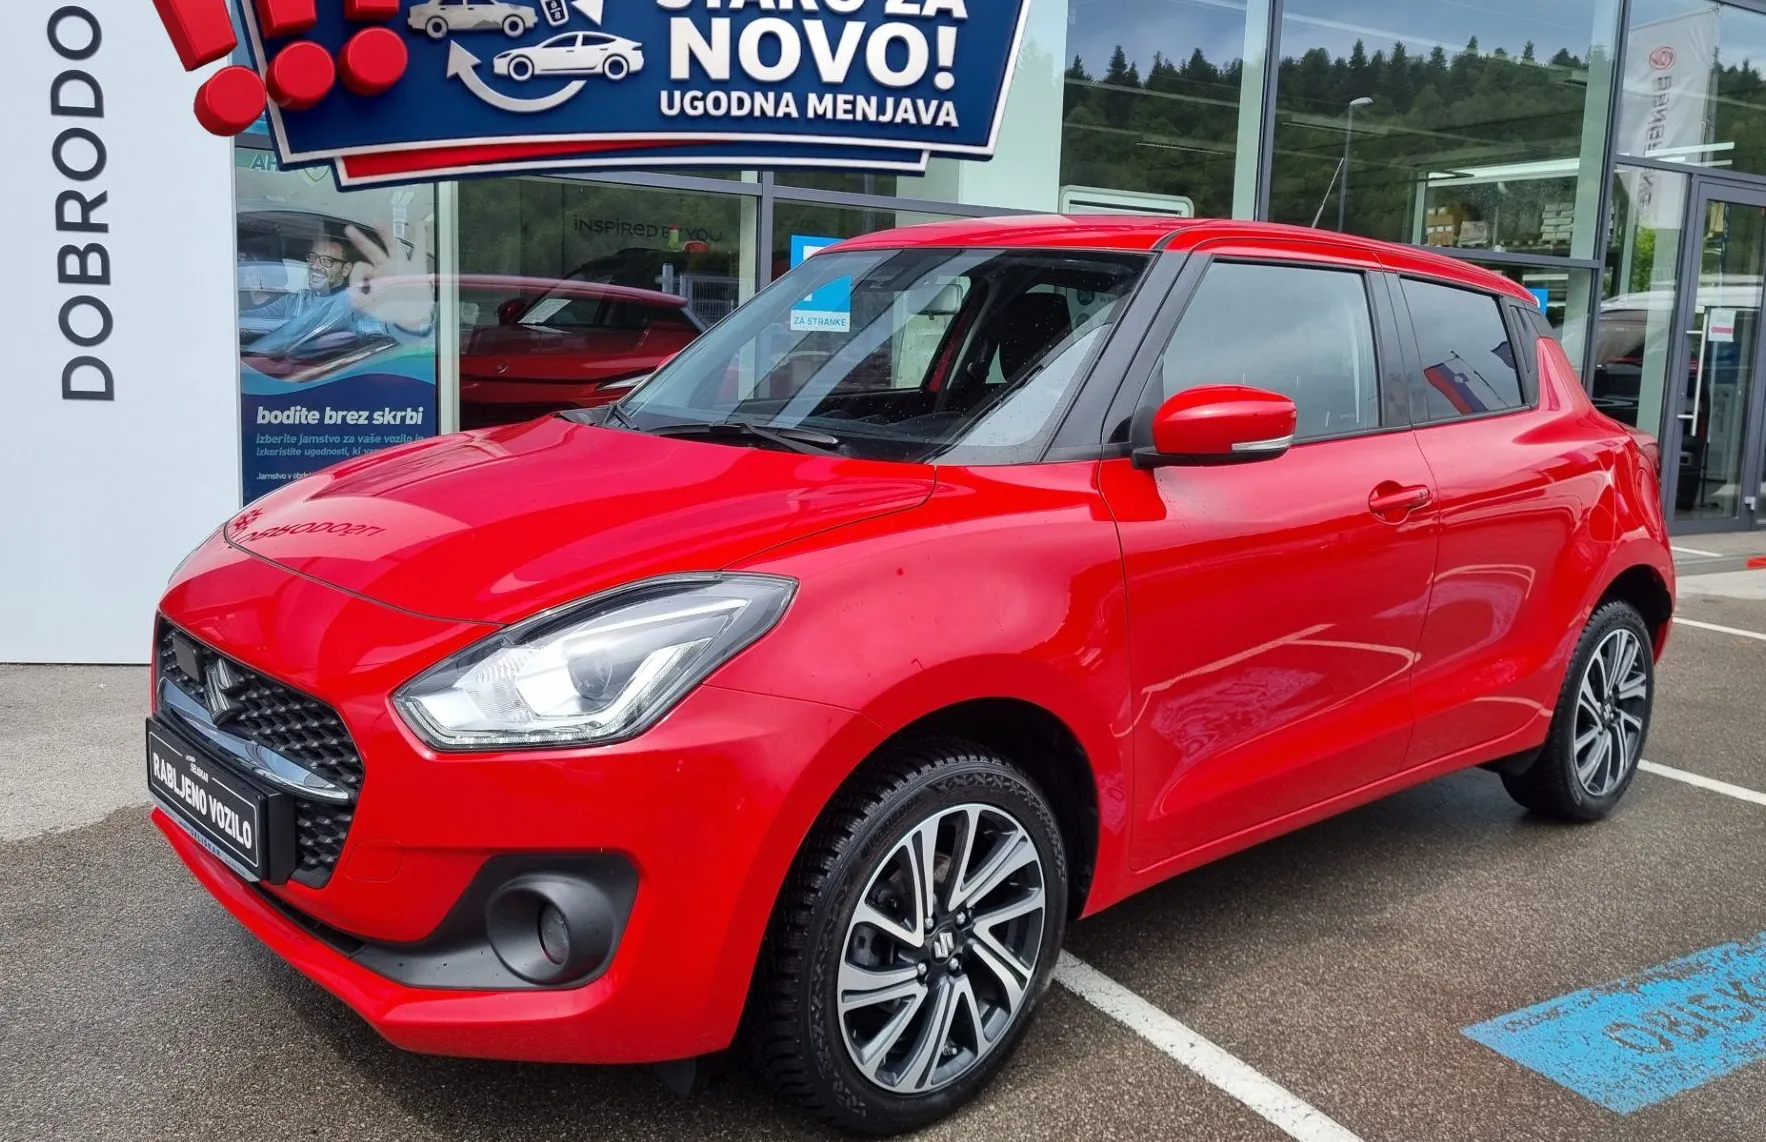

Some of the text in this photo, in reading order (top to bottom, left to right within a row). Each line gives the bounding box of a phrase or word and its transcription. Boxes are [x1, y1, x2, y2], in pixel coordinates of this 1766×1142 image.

[46, 5, 115, 402] DOBRODO
[661, 225, 682, 239] B
[793, 316, 847, 327] ZA STRANKE
[256, 405, 424, 425] bodite brez skrbi
[256, 433, 297, 444] izberite
[298, 433, 341, 446] jamstvo
[342, 435, 355, 444] za
[357, 432, 381, 444] vaše
[384, 433, 413, 444] vozilo
[256, 447, 301, 457] izkoristite
[304, 447, 350, 458] ugodnosti,
[152, 752, 252, 850] RABLJENO VOZILO
[1602, 972, 1766, 1053] OBISK
